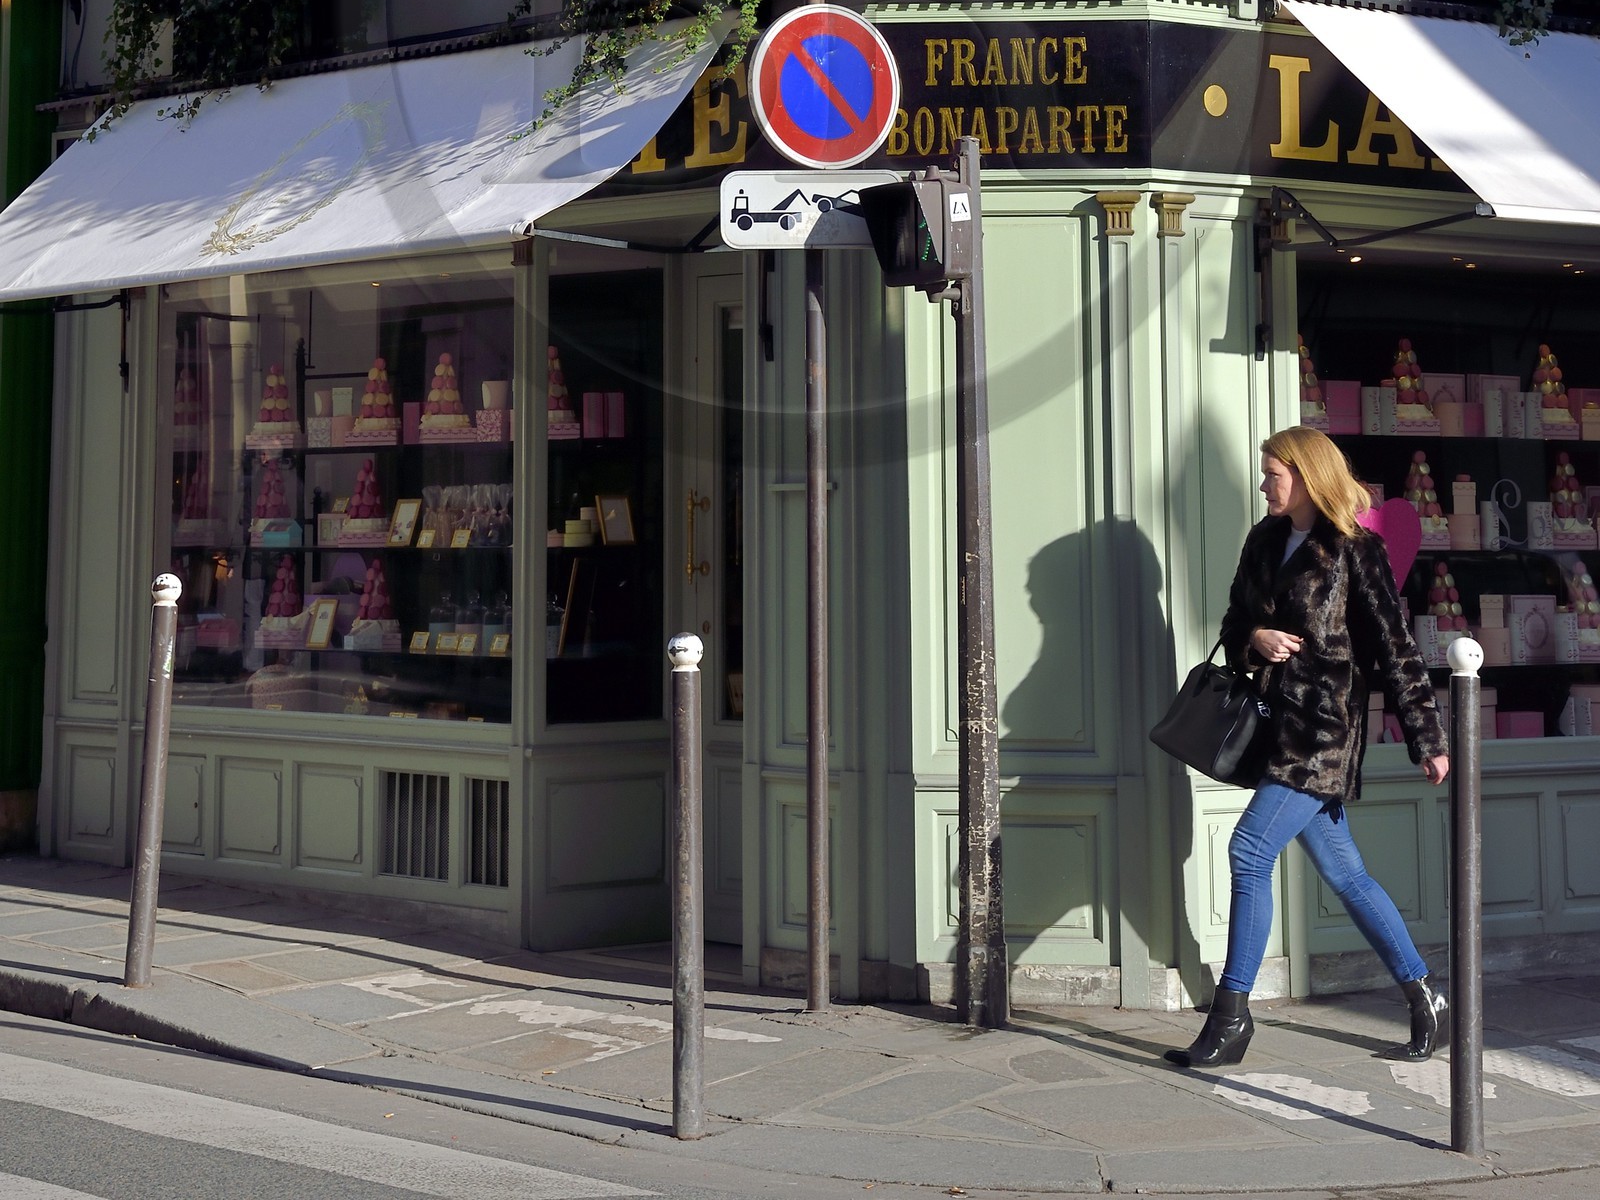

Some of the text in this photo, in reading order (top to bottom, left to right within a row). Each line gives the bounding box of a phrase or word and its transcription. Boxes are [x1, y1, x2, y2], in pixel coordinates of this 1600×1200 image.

[923, 36, 1088, 87] FRANCE
[885, 104, 1129, 156] BONAPARTE
[1268, 53, 1454, 173] LA
